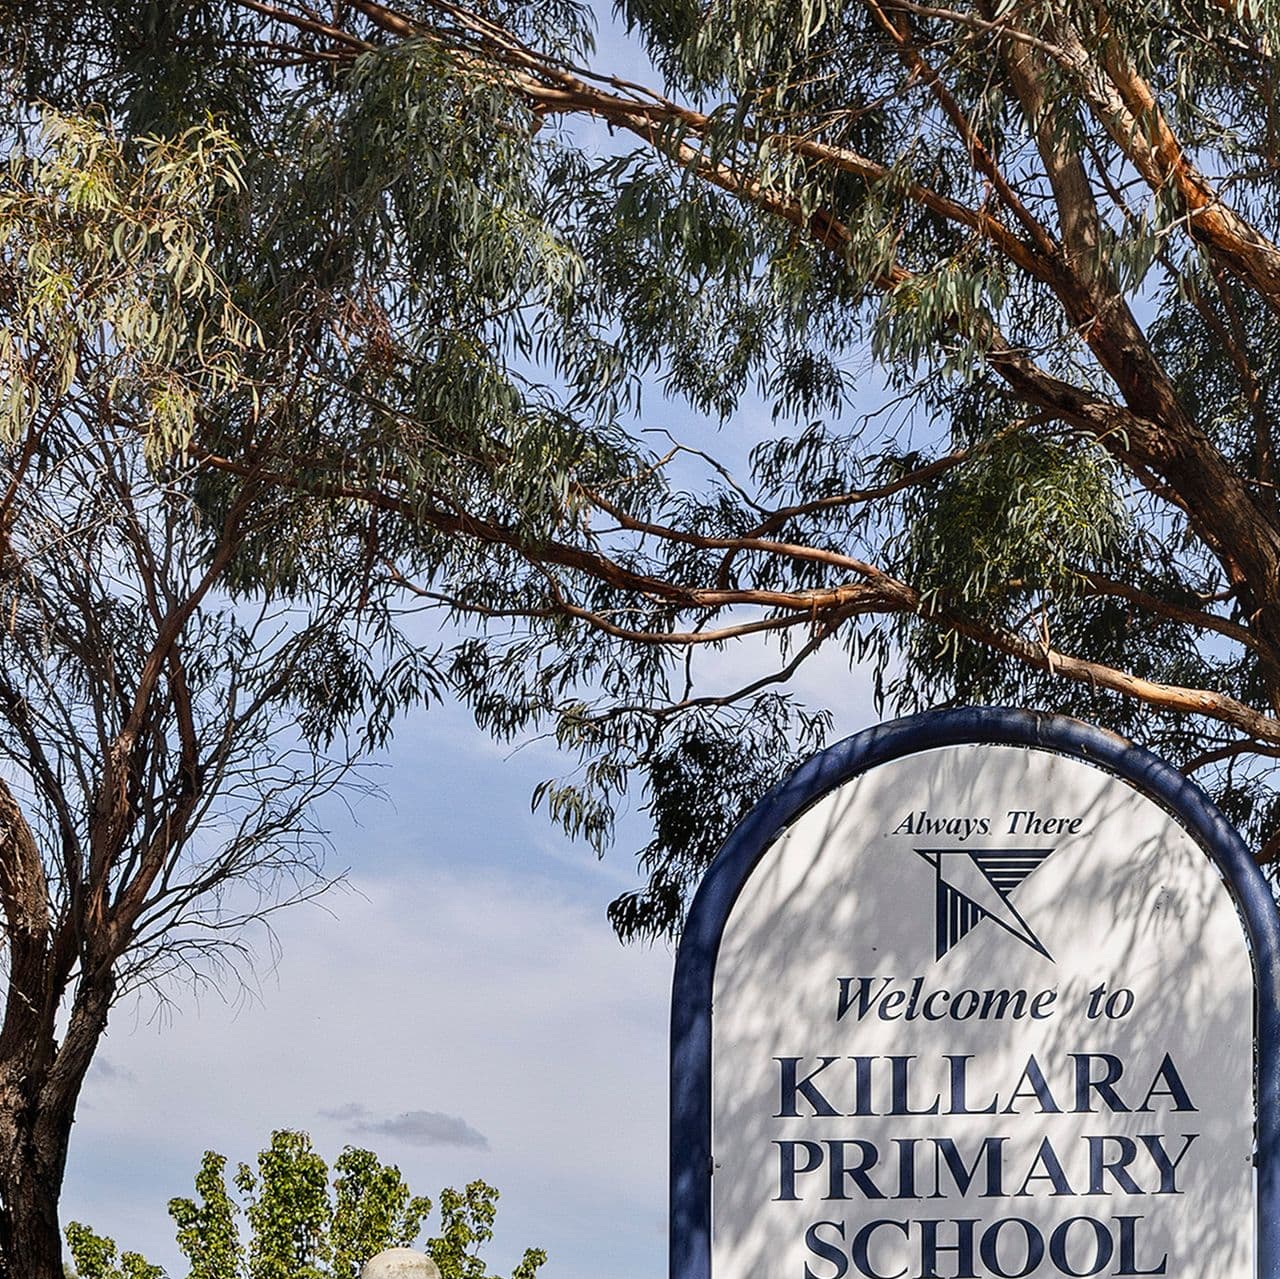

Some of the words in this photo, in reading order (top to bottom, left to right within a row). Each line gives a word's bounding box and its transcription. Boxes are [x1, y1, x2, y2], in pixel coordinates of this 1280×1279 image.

[892, 811, 991, 841] Always
[1007, 811, 1083, 835] There
[837, 976, 1057, 1022] Welcome
[1087, 982, 1135, 1020] to
[771, 1051, 1200, 1118] KILLARA
[771, 1133, 1201, 1201] PRIMARY
